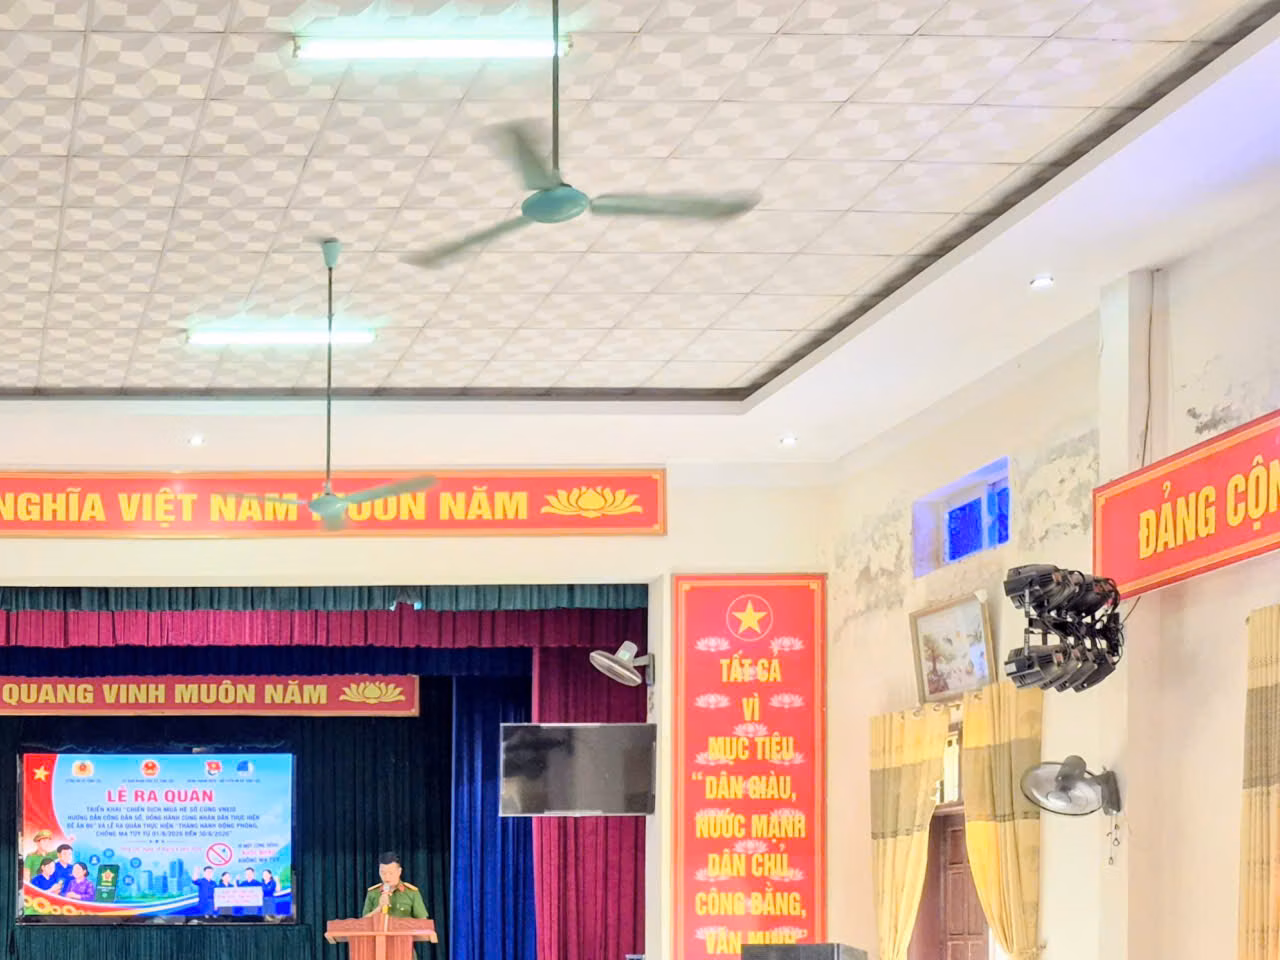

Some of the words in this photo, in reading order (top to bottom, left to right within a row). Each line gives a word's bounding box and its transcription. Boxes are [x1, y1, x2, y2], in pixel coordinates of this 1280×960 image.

[119, 484, 197, 528] VIỆT
[211, 491, 298, 521] NAM
[311, 491, 426, 521] UÔN
[439, 484, 527, 520] NĂM
[1138, 481, 1216, 559] ĐẢNG
[720, 649, 753, 682] TẤT
[756, 647, 782, 682] CẢ
[2, 683, 94, 706] QUANG
[102, 683, 165, 704] VINH
[175, 680, 256, 704] MUÔN
[264, 680, 328, 705] NĂM
[742, 692, 760, 721] VÌ
[708, 735, 749, 765] MỤC
[754, 731, 795, 760] TIÊU
[134, 789, 158, 802] RA
[748, 770, 796, 801] GIÀU,
[751, 814, 806, 843] MẠNH
[708, 848, 746, 877] DÂN
[696, 887, 746, 916] CÔNG
[751, 881, 806, 919] BẰNG,
[705, 926, 742, 954] VĂN
